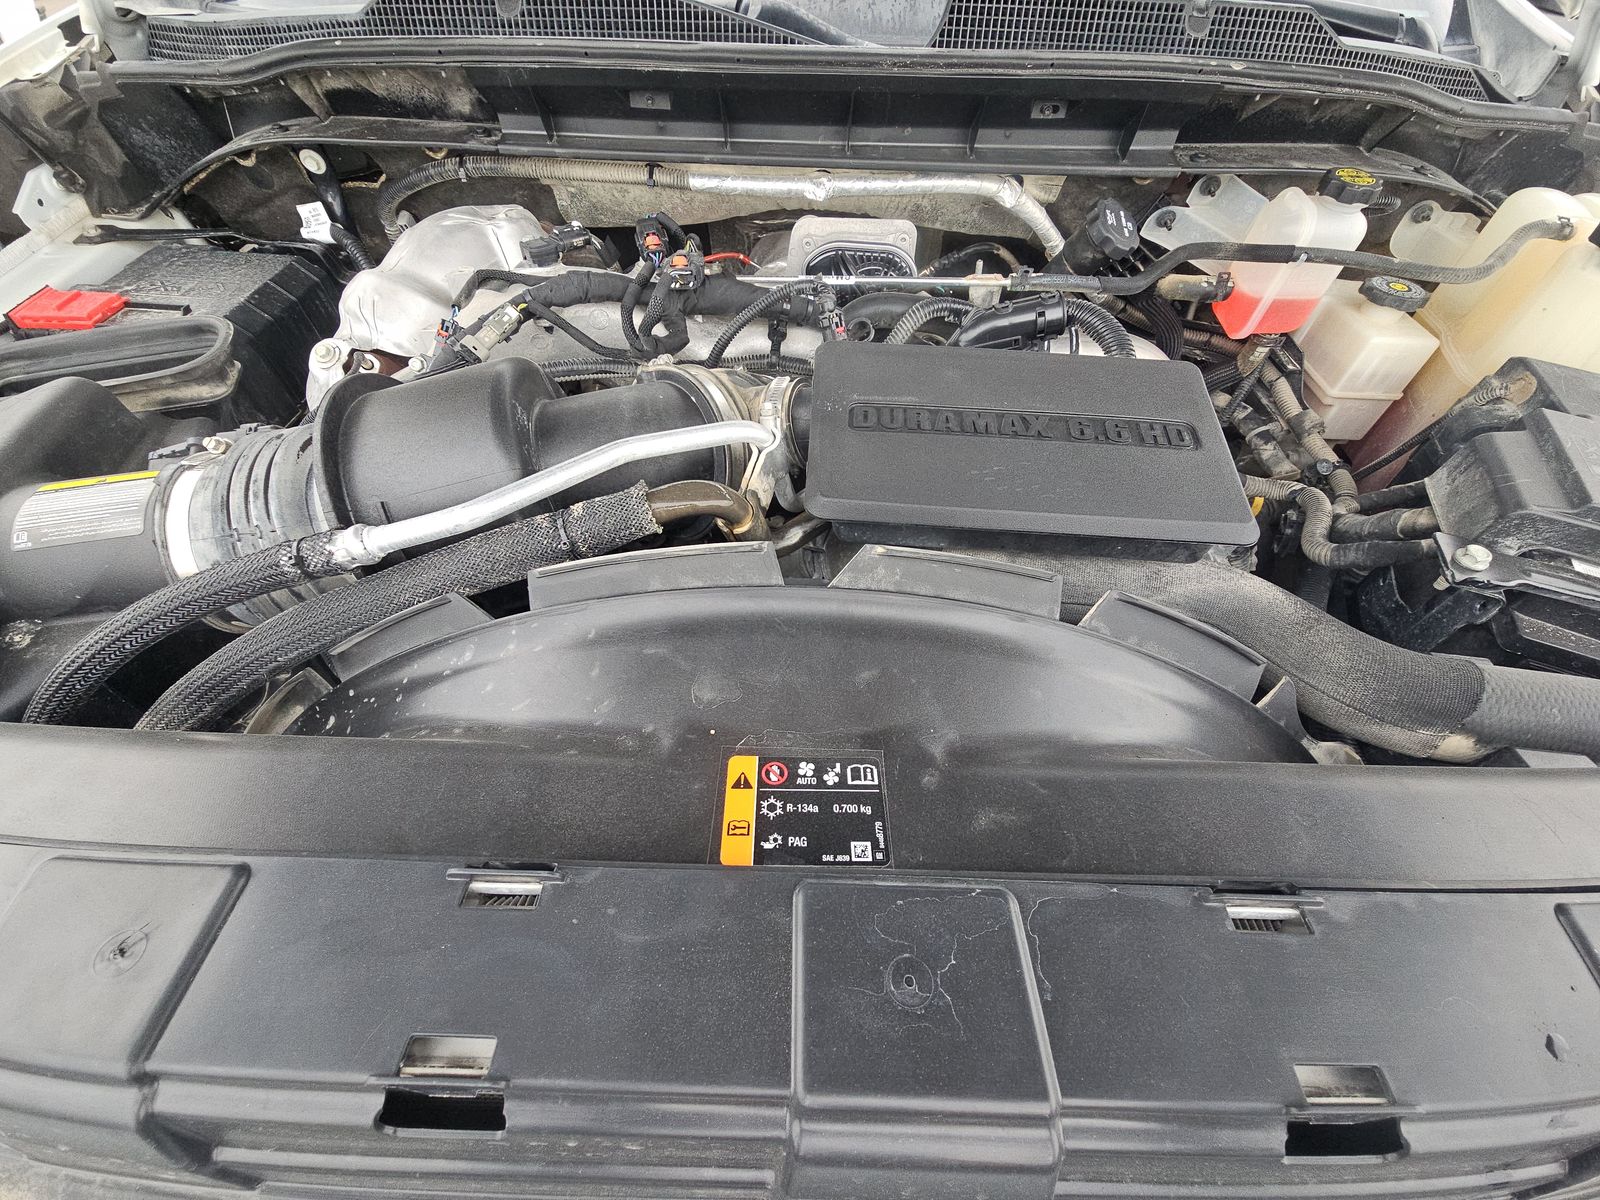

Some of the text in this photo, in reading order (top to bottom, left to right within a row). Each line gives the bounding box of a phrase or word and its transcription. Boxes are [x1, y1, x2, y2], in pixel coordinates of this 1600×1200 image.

[852, 406, 1194, 448] DURAMAX 6.6 HD
[796, 777, 817, 785] AUTO
[787, 803, 872, 815] R-134a 0.700 kg
[788, 836, 808, 847] PAG
[822, 854, 835, 862] SAE
